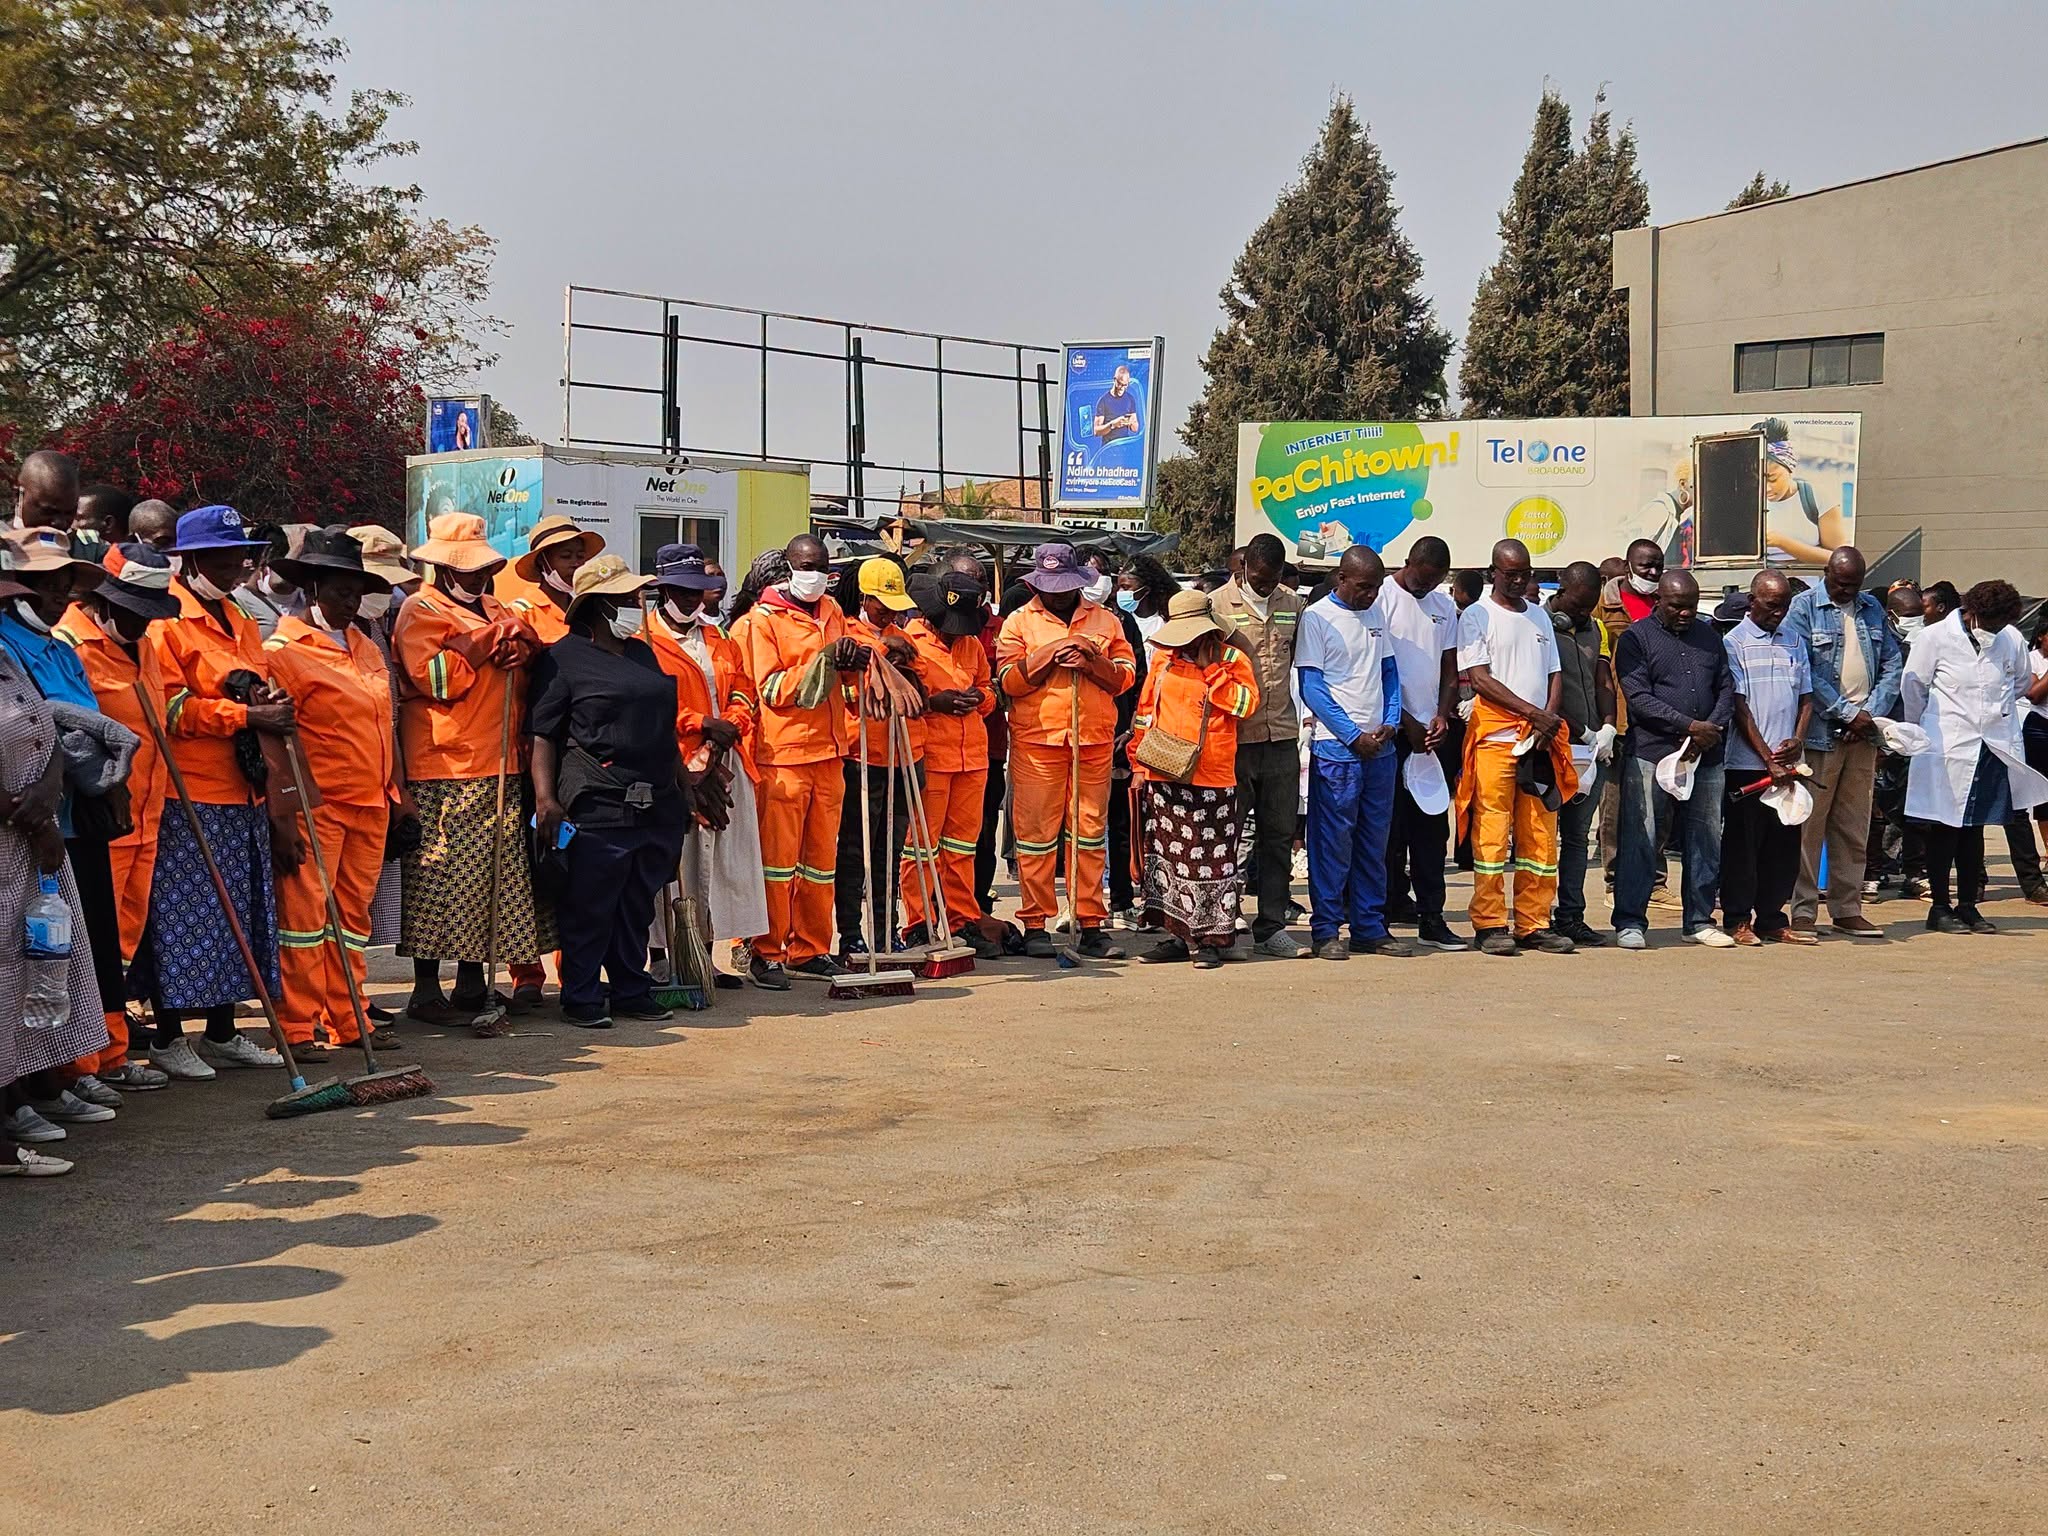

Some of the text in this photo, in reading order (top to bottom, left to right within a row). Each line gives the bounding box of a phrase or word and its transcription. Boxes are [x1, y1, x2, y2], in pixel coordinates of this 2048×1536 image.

[1285, 429, 1351, 456] INTERNET
[1486, 439, 1586, 464] TelOne
[1067, 466, 1139, 477] Ndino bhadhara
[1249, 431, 1460, 510] PaChitown!
[1528, 466, 1586, 475] BROADBAND
[645, 477, 708, 494] NetOne
[487, 488, 529, 504] NetOne
[665, 495, 680, 503] World
[570, 499, 608, 507] Registration
[1295, 489, 1406, 520] Enjoy Fast Internet
[1520, 521, 1554, 529] Smarter
[1514, 532, 1560, 540] Affordable
